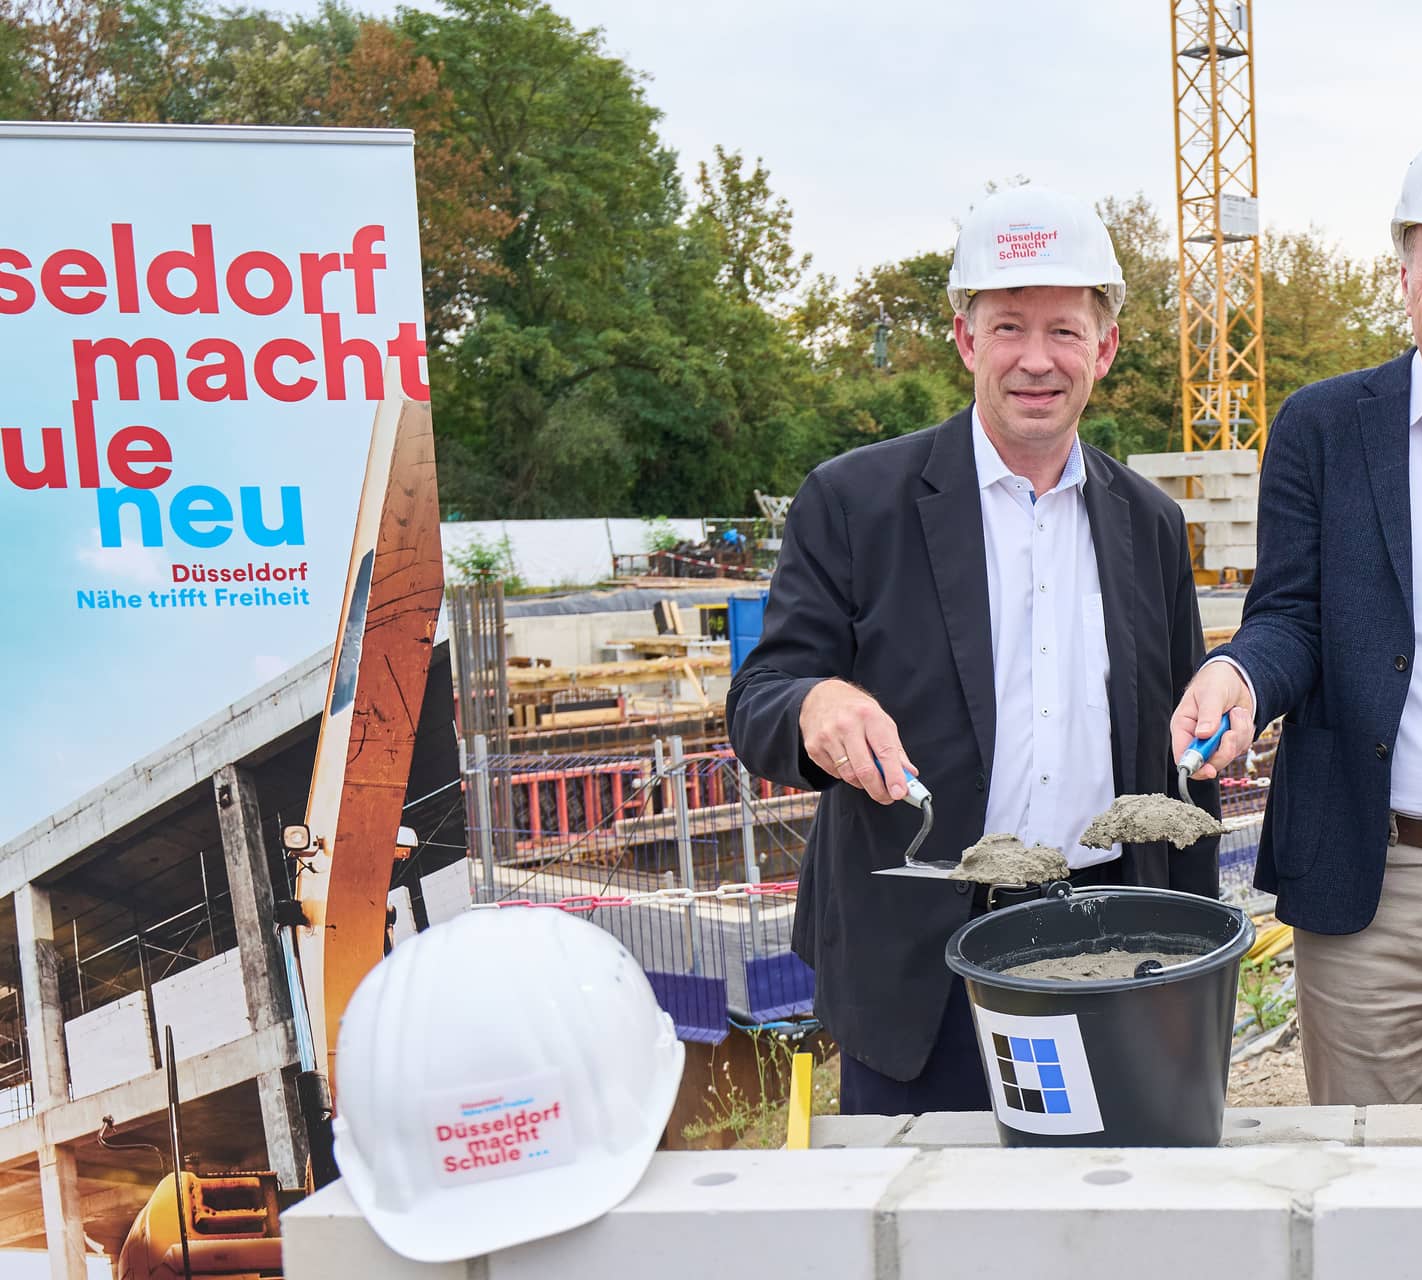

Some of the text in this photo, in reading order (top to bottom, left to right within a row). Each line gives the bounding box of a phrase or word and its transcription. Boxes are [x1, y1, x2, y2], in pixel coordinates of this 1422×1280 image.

[997, 231, 1057, 244] Düsseldorf
[1010, 240, 1046, 250] macht
[999, 248, 1037, 260] Schule
[72, 312, 431, 403] macht
[96, 485, 306, 549] neu
[172, 562, 308, 583] Düsseldorf
[76, 586, 310, 609] Nähe trifft Freiheit
[436, 1102, 560, 1142] Düsseldorf
[467, 1127, 539, 1154] macht
[444, 1147, 521, 1172] Schule
